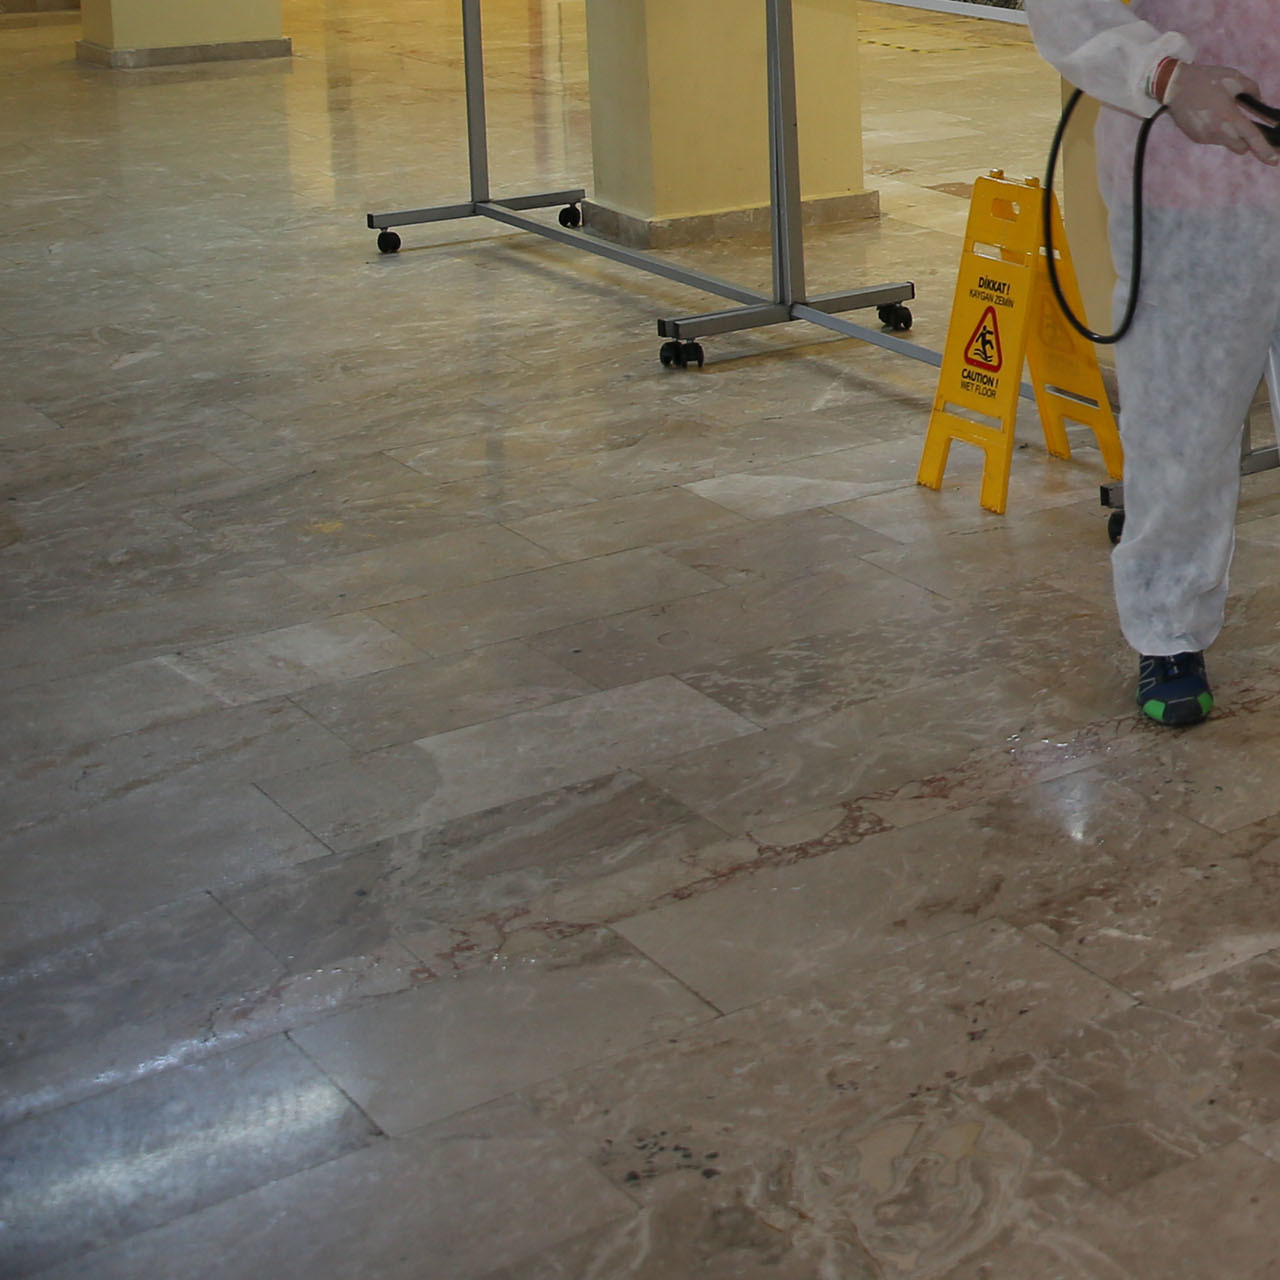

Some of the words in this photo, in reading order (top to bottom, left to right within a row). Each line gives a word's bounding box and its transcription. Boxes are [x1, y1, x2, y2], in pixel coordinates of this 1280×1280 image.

[969, 289, 994, 303] KAYGAN
[994, 295, 1014, 308] ZEMİN
[961, 368, 994, 387] CAUTION
[960, 380, 974, 392] WET
[974, 384, 997, 399] FLOOR
